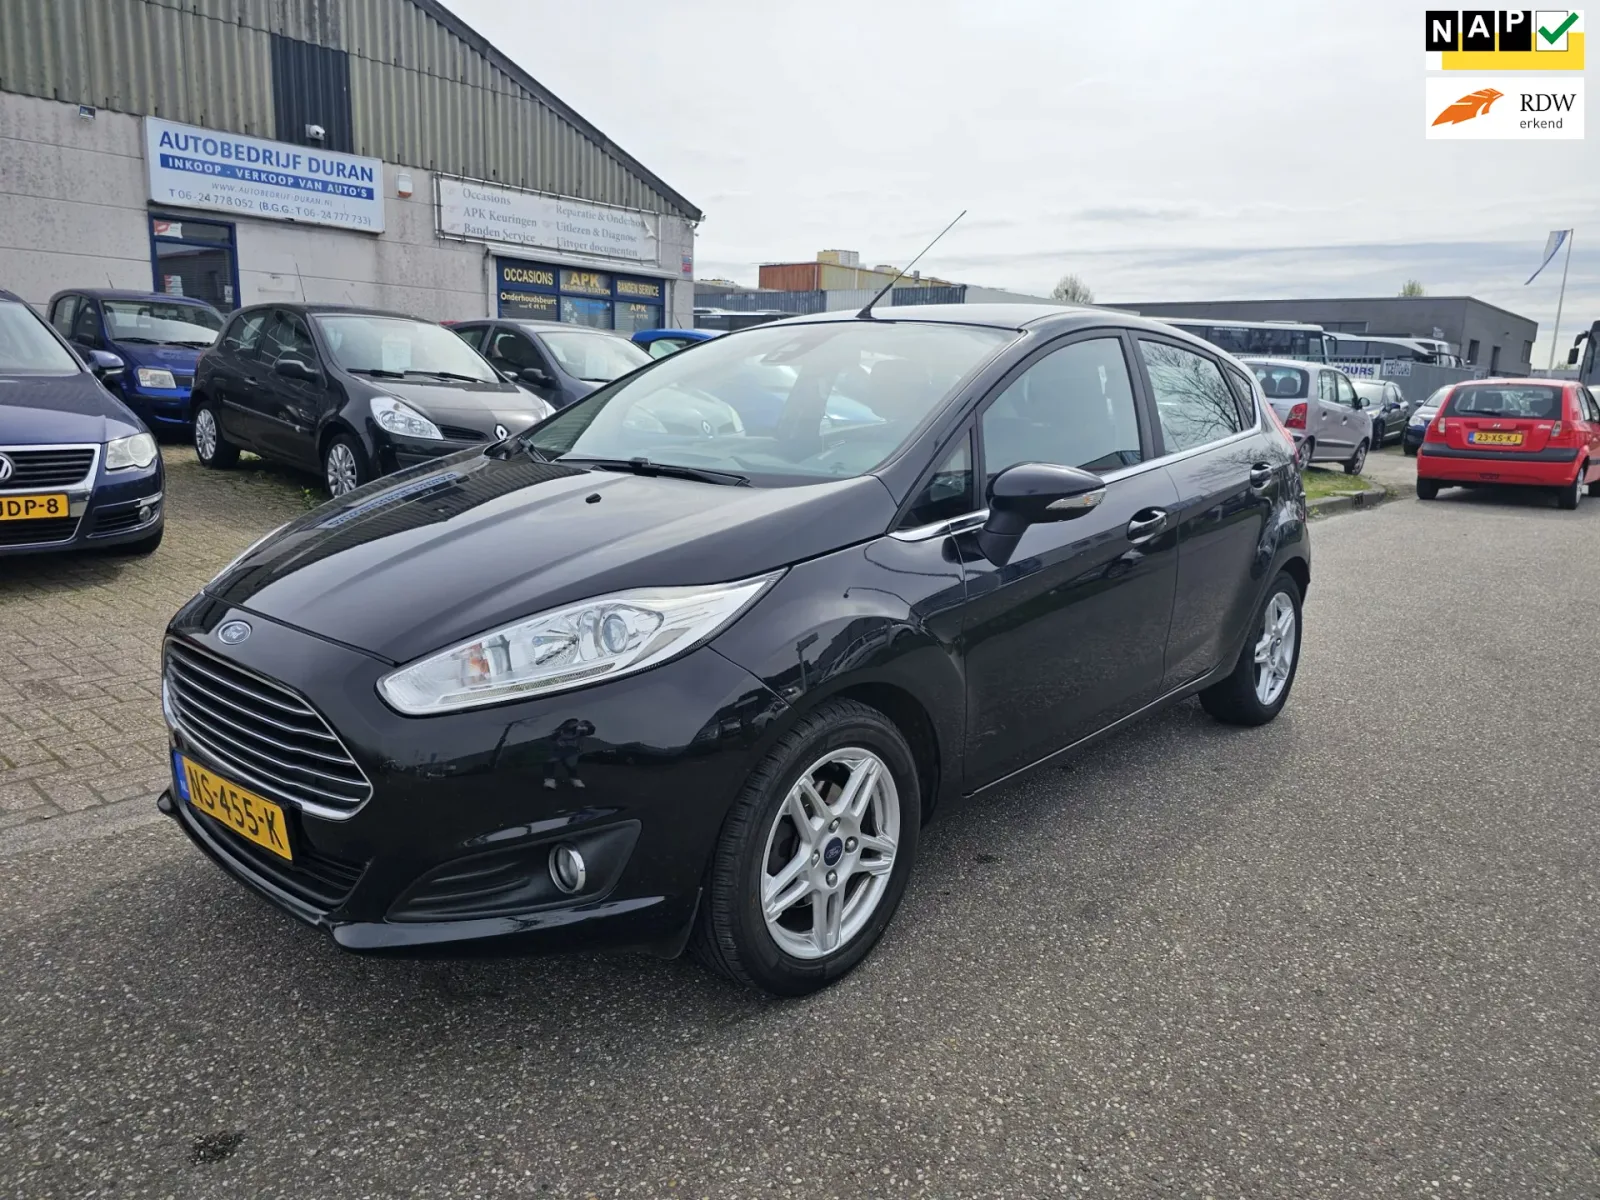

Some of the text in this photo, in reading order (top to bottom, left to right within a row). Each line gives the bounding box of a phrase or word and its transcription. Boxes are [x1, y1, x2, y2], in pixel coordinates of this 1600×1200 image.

[159, 130, 374, 183] AUTOBEDRIJF DURAN
[169, 156, 222, 175] INKOOP
[235, 168, 295, 187] VERKOOP
[299, 179, 323, 191] VAN
[327, 184, 368, 198] AUTO'S
[462, 188, 512, 206] Occasions
[463, 206, 537, 228] APK Keuringen
[464, 222, 536, 244] Banden Service
[556, 221, 591, 236] Uitlezen
[602, 228, 637, 244] Diagnose
[503, 267, 554, 286] OCCASIONS
[570, 271, 600, 289] APK
[500, 291, 558, 306] Onderhoudsbeurt
[629, 303, 647, 313] APK
[187, 765, 285, 851] NS-455-K
